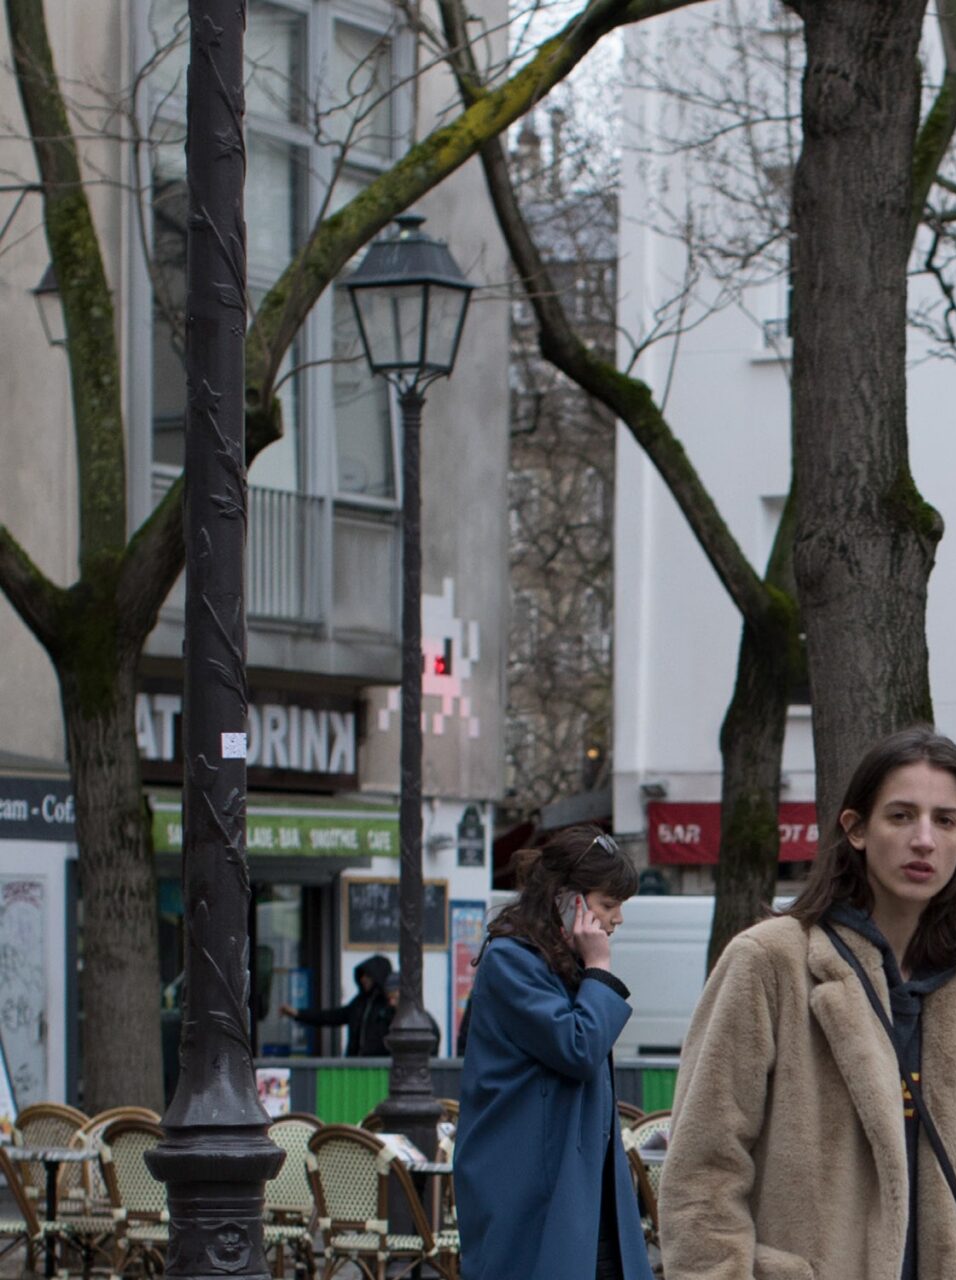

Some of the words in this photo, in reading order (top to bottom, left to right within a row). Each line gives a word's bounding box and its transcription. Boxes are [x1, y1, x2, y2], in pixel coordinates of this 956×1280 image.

[135, 693, 182, 761] AT
[246, 704, 356, 775] DRINK
[658, 823, 701, 844] BAR
